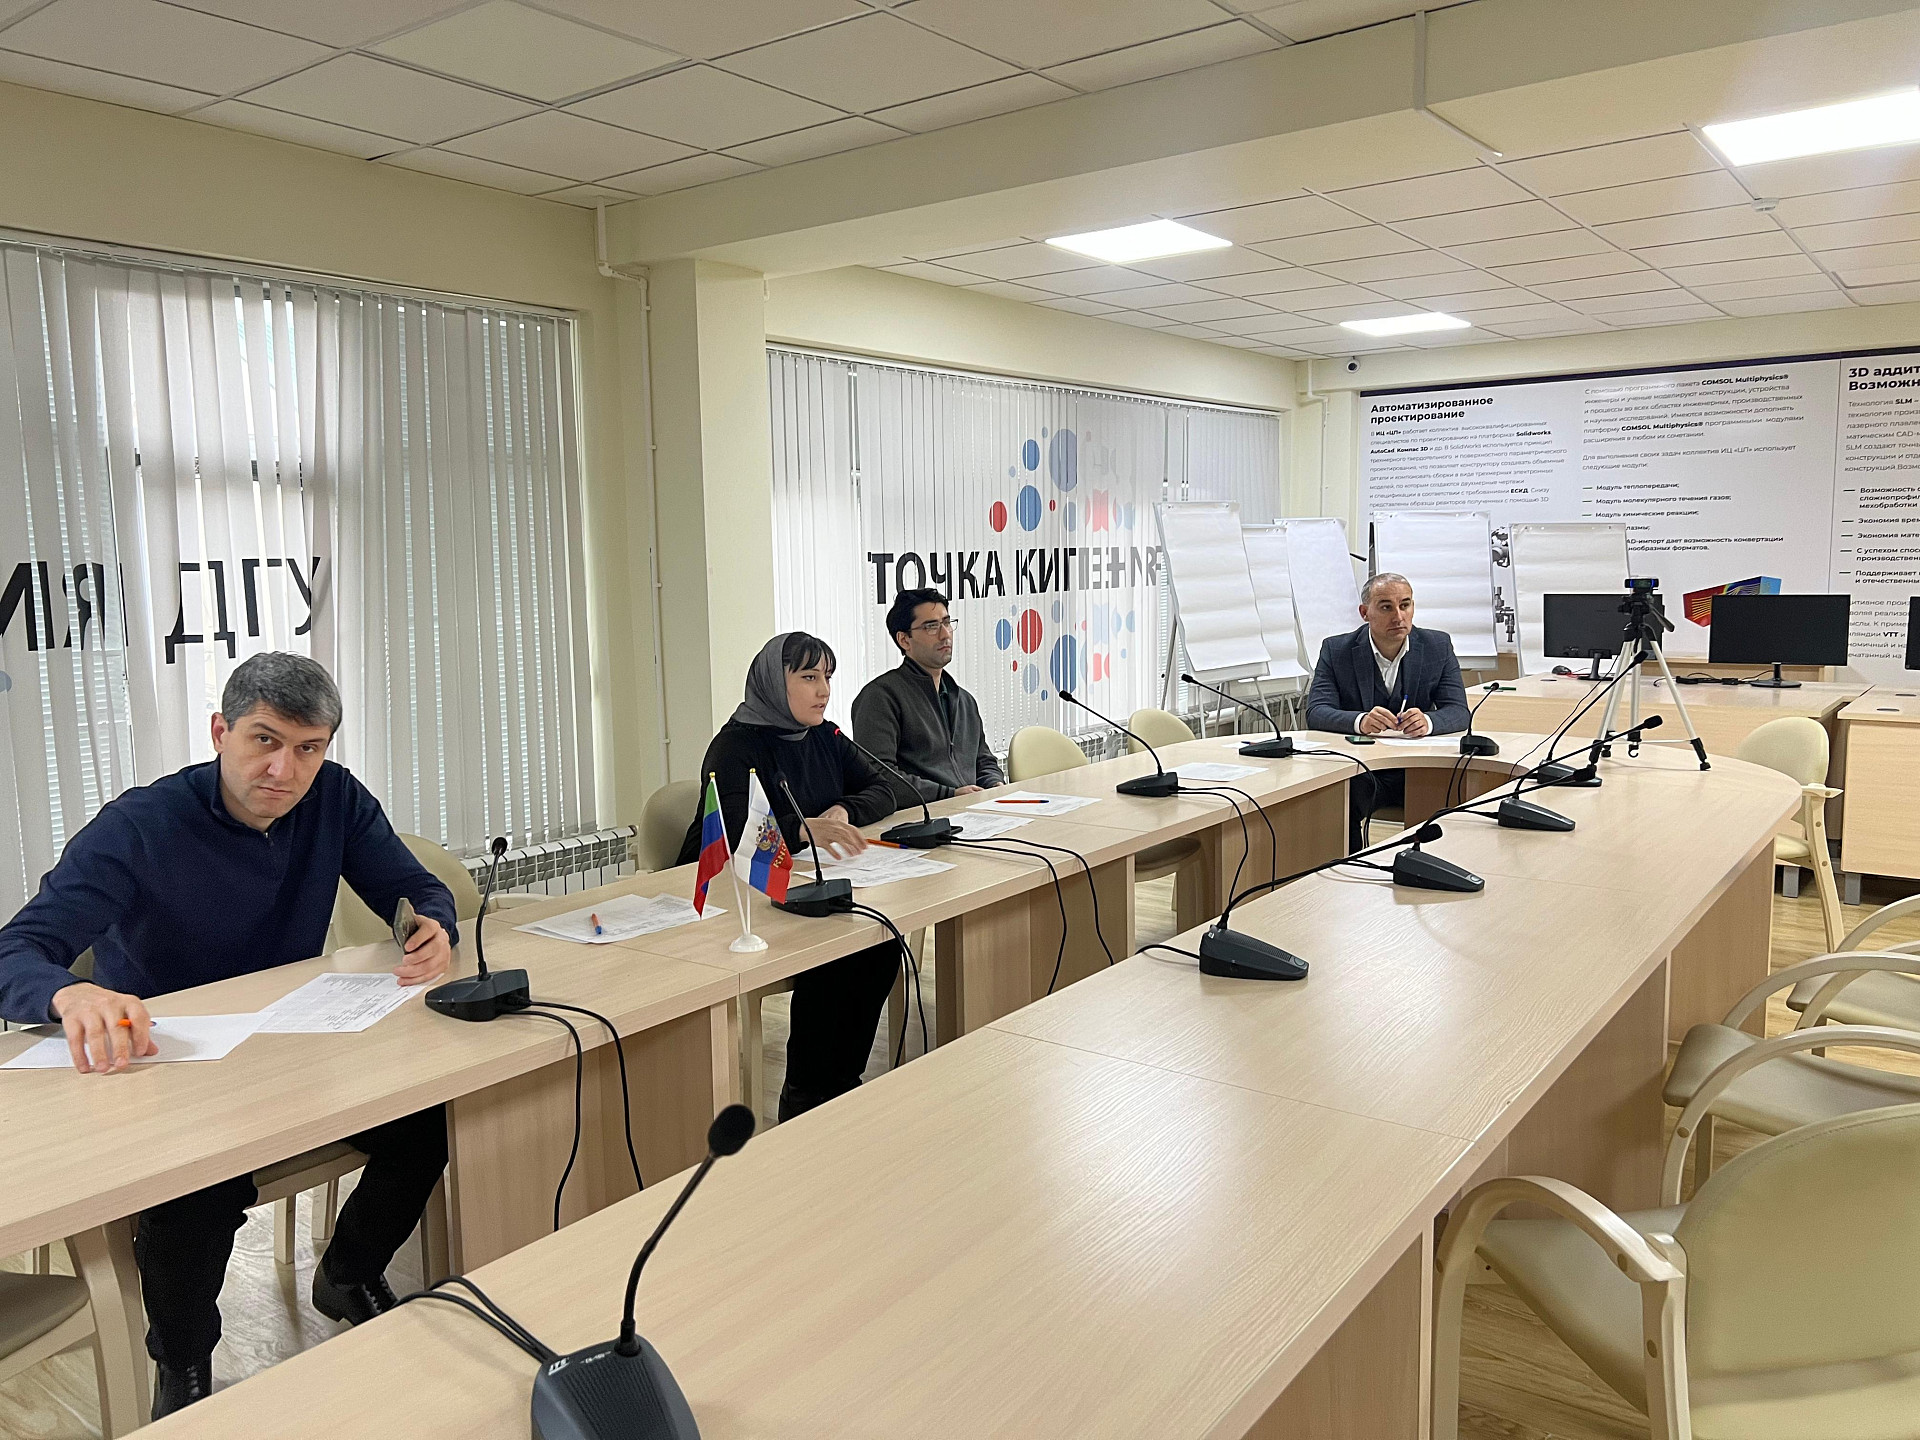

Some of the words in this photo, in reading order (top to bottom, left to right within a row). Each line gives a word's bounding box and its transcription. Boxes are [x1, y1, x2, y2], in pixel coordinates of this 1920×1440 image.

[1849, 368, 1869, 377] 3D
[1702, 377, 1733, 385] COMSOL
[1371, 398, 1493, 413] Автоматизированное
[1371, 411, 1465, 425] проектирование
[868, 551, 1005, 604] ТОЧКА
[165, 557, 320, 664] ДГУ
